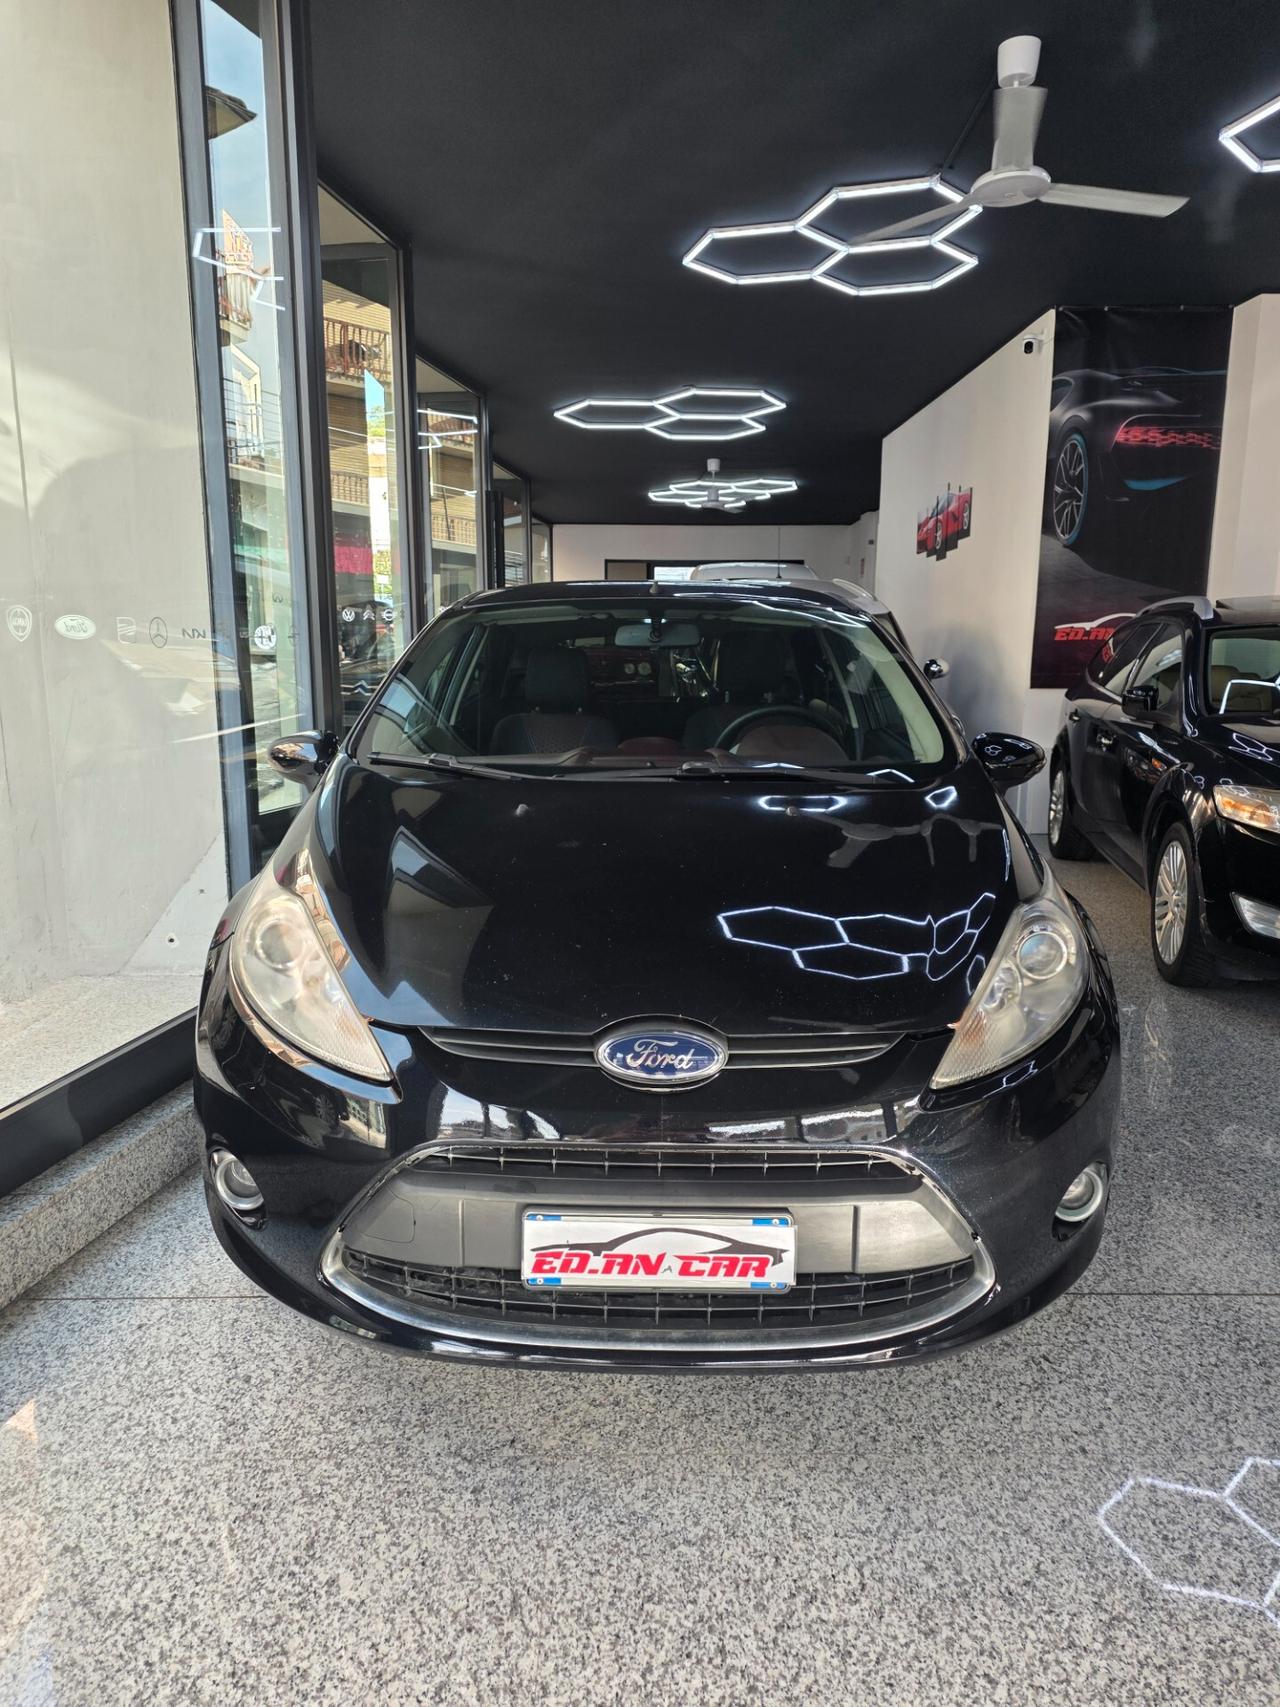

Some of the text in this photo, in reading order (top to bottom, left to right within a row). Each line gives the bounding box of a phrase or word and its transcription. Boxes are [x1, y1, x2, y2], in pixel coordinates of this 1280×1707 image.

[626, 1039, 696, 1070] Ford
[530, 1251, 772, 1278] ED.AN CAR
